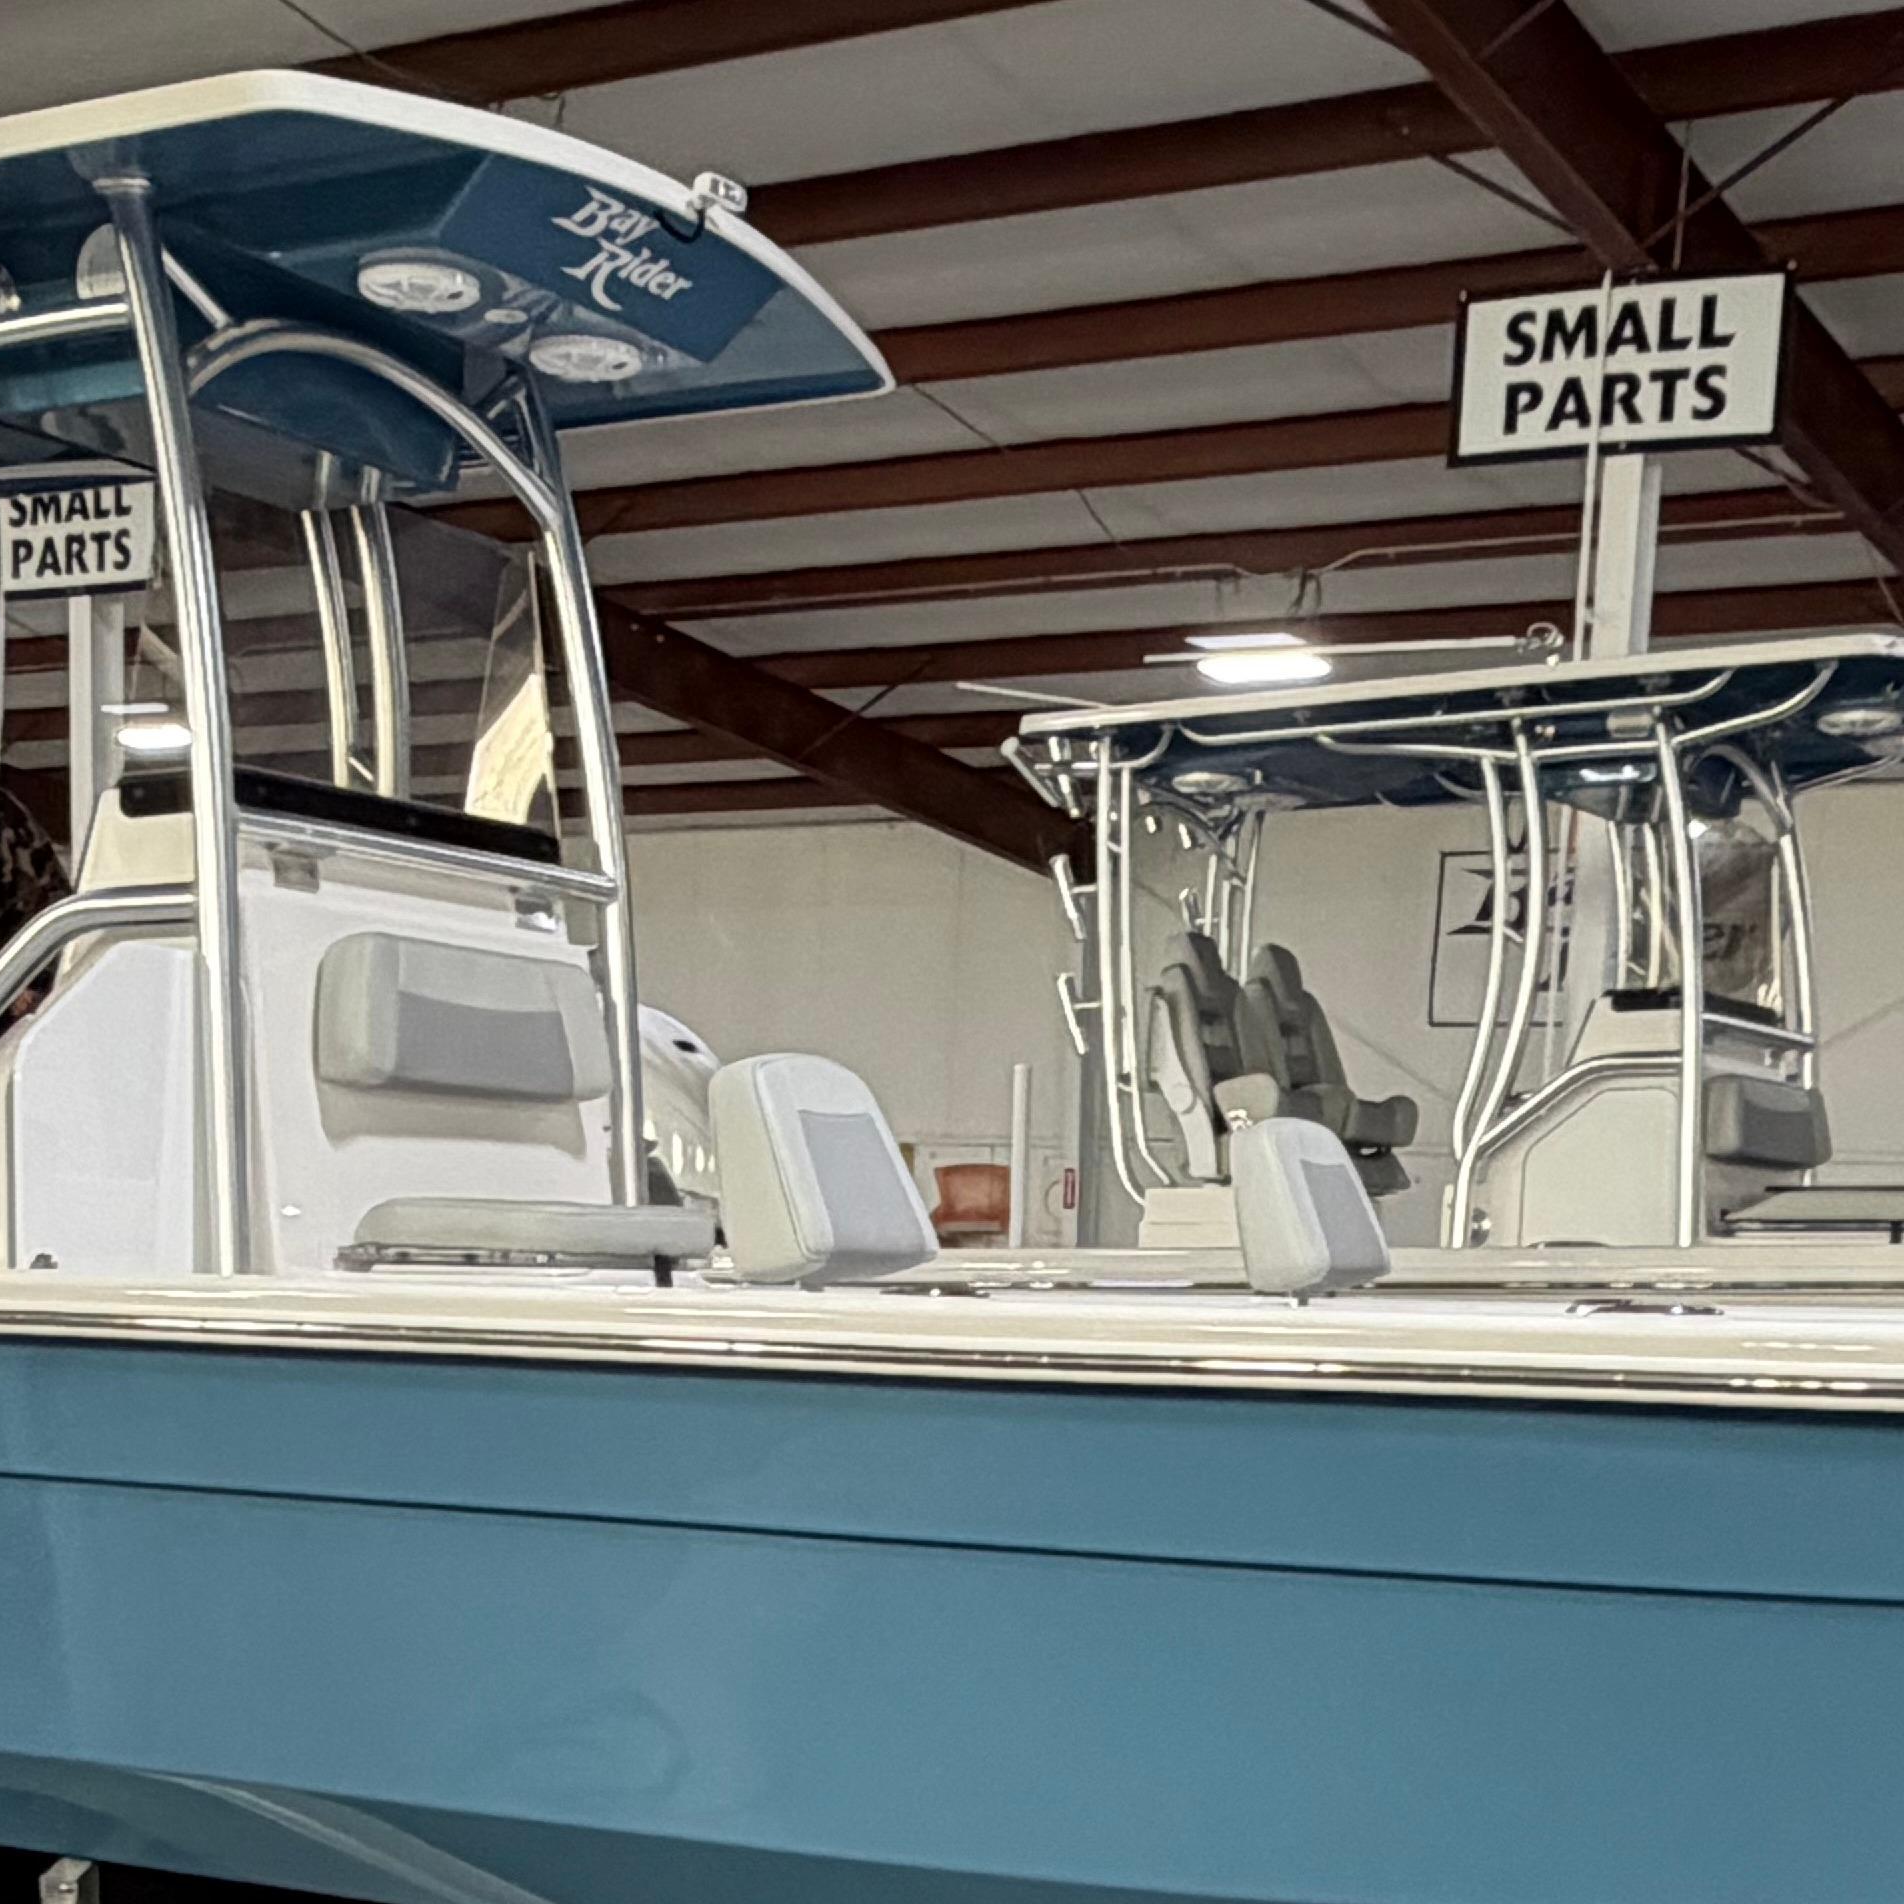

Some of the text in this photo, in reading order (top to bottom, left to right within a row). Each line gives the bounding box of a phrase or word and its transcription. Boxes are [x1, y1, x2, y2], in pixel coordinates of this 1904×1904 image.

[551, 185, 661, 246] Bay
[559, 236, 693, 312] Rider
[1503, 294, 1736, 366] SMALL
[1503, 365, 1727, 435] PARTS
[8, 485, 132, 528] SMALL
[10, 528, 132, 580] PARTS
